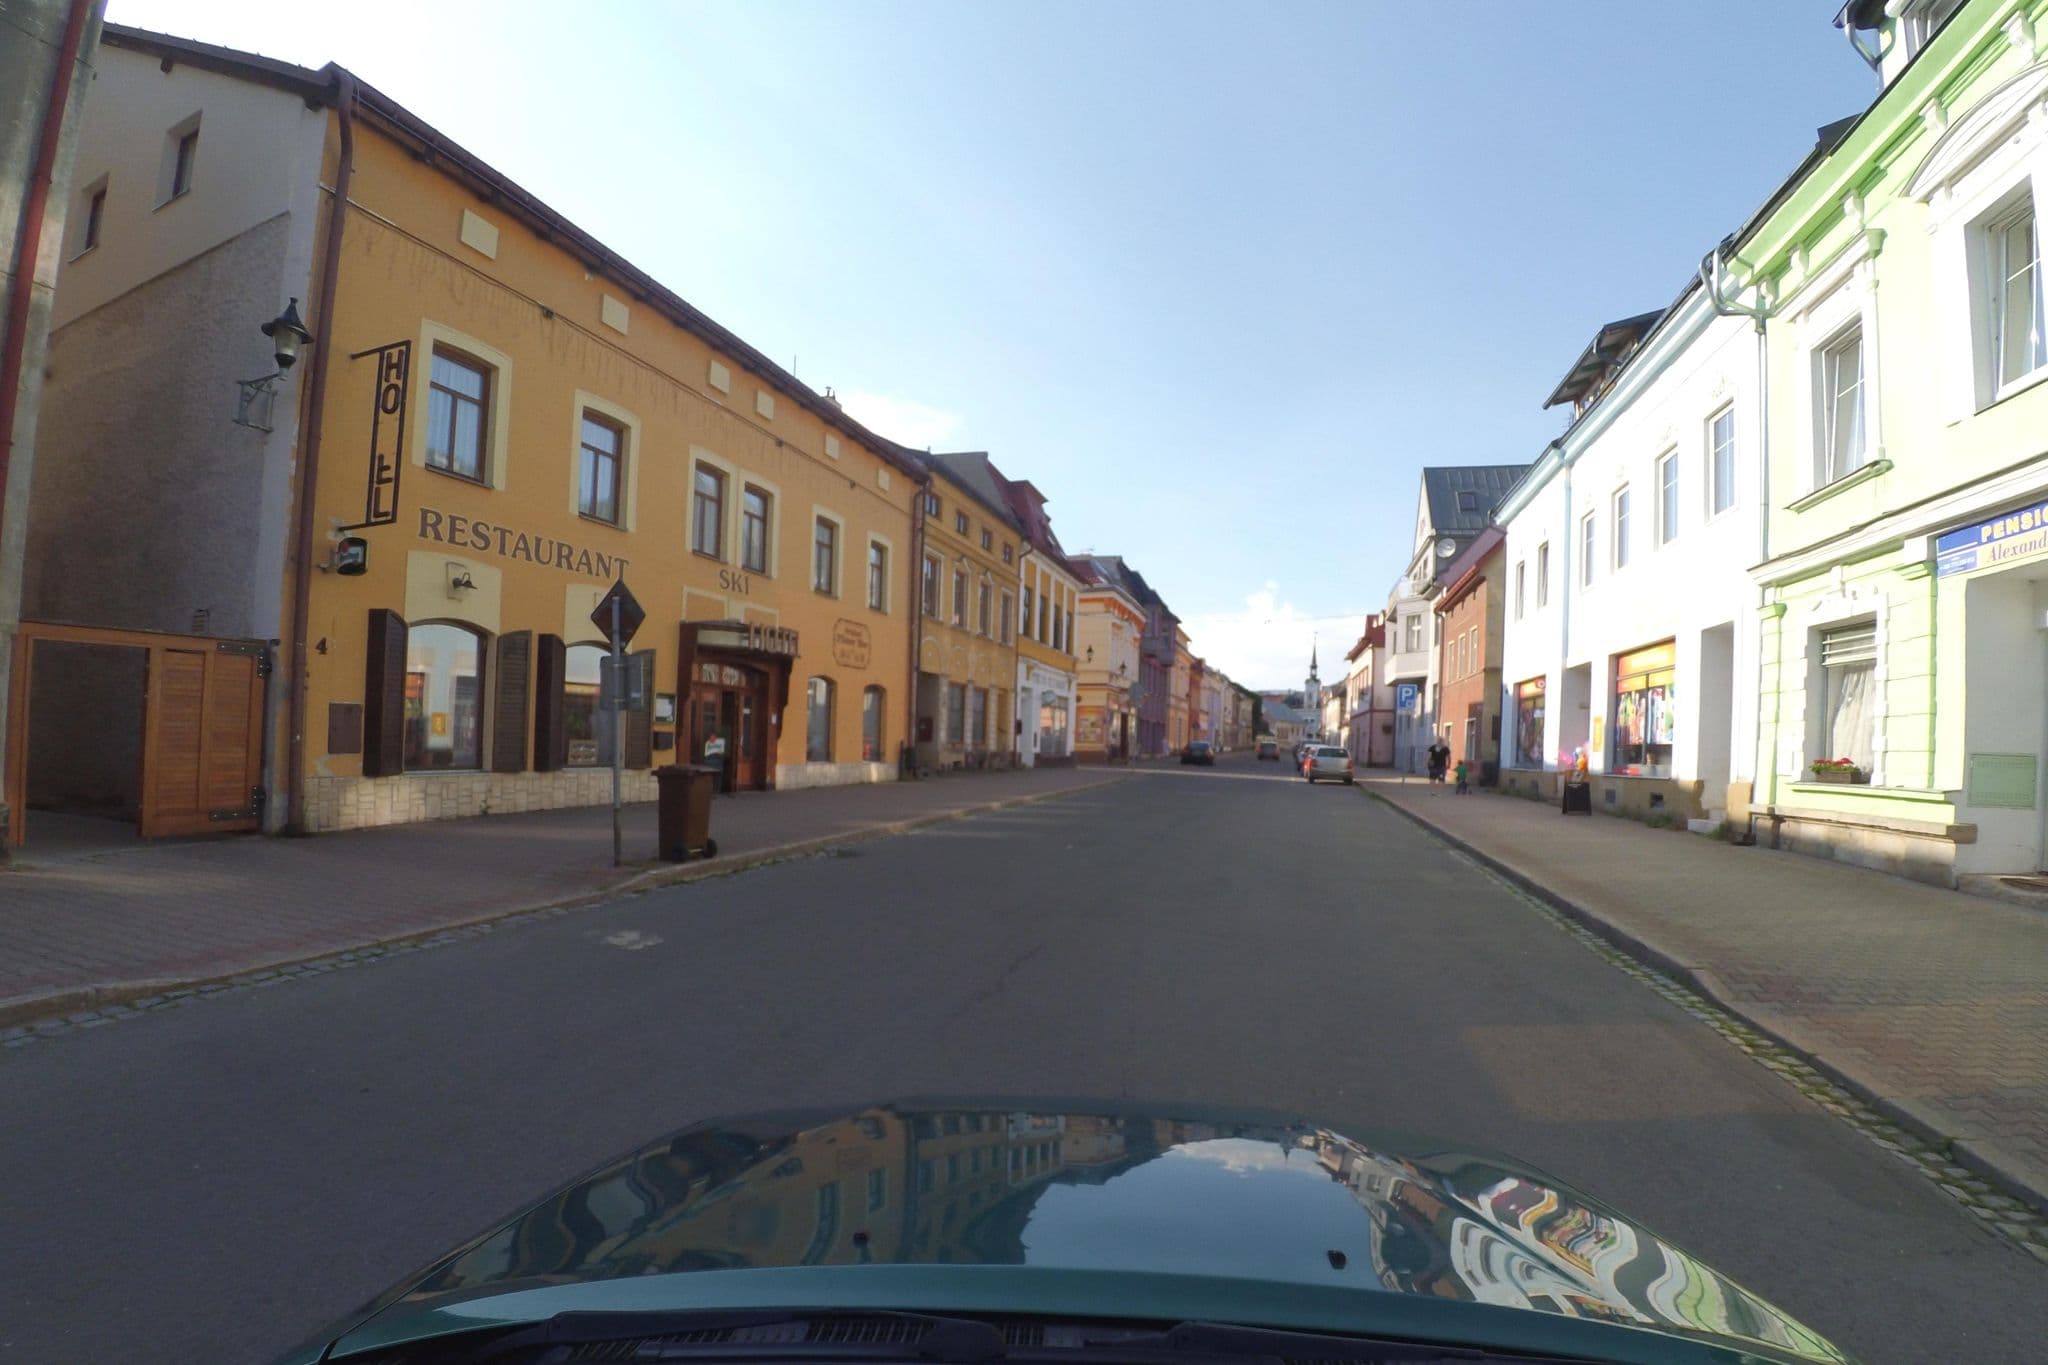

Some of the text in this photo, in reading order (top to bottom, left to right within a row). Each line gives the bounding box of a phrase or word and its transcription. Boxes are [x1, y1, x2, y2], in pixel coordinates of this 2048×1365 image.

[418, 507, 629, 580] RESTAURANT
[719, 569, 749, 595] SKI
[314, 636, 328, 655] 4
[1401, 687, 1413, 702] P
